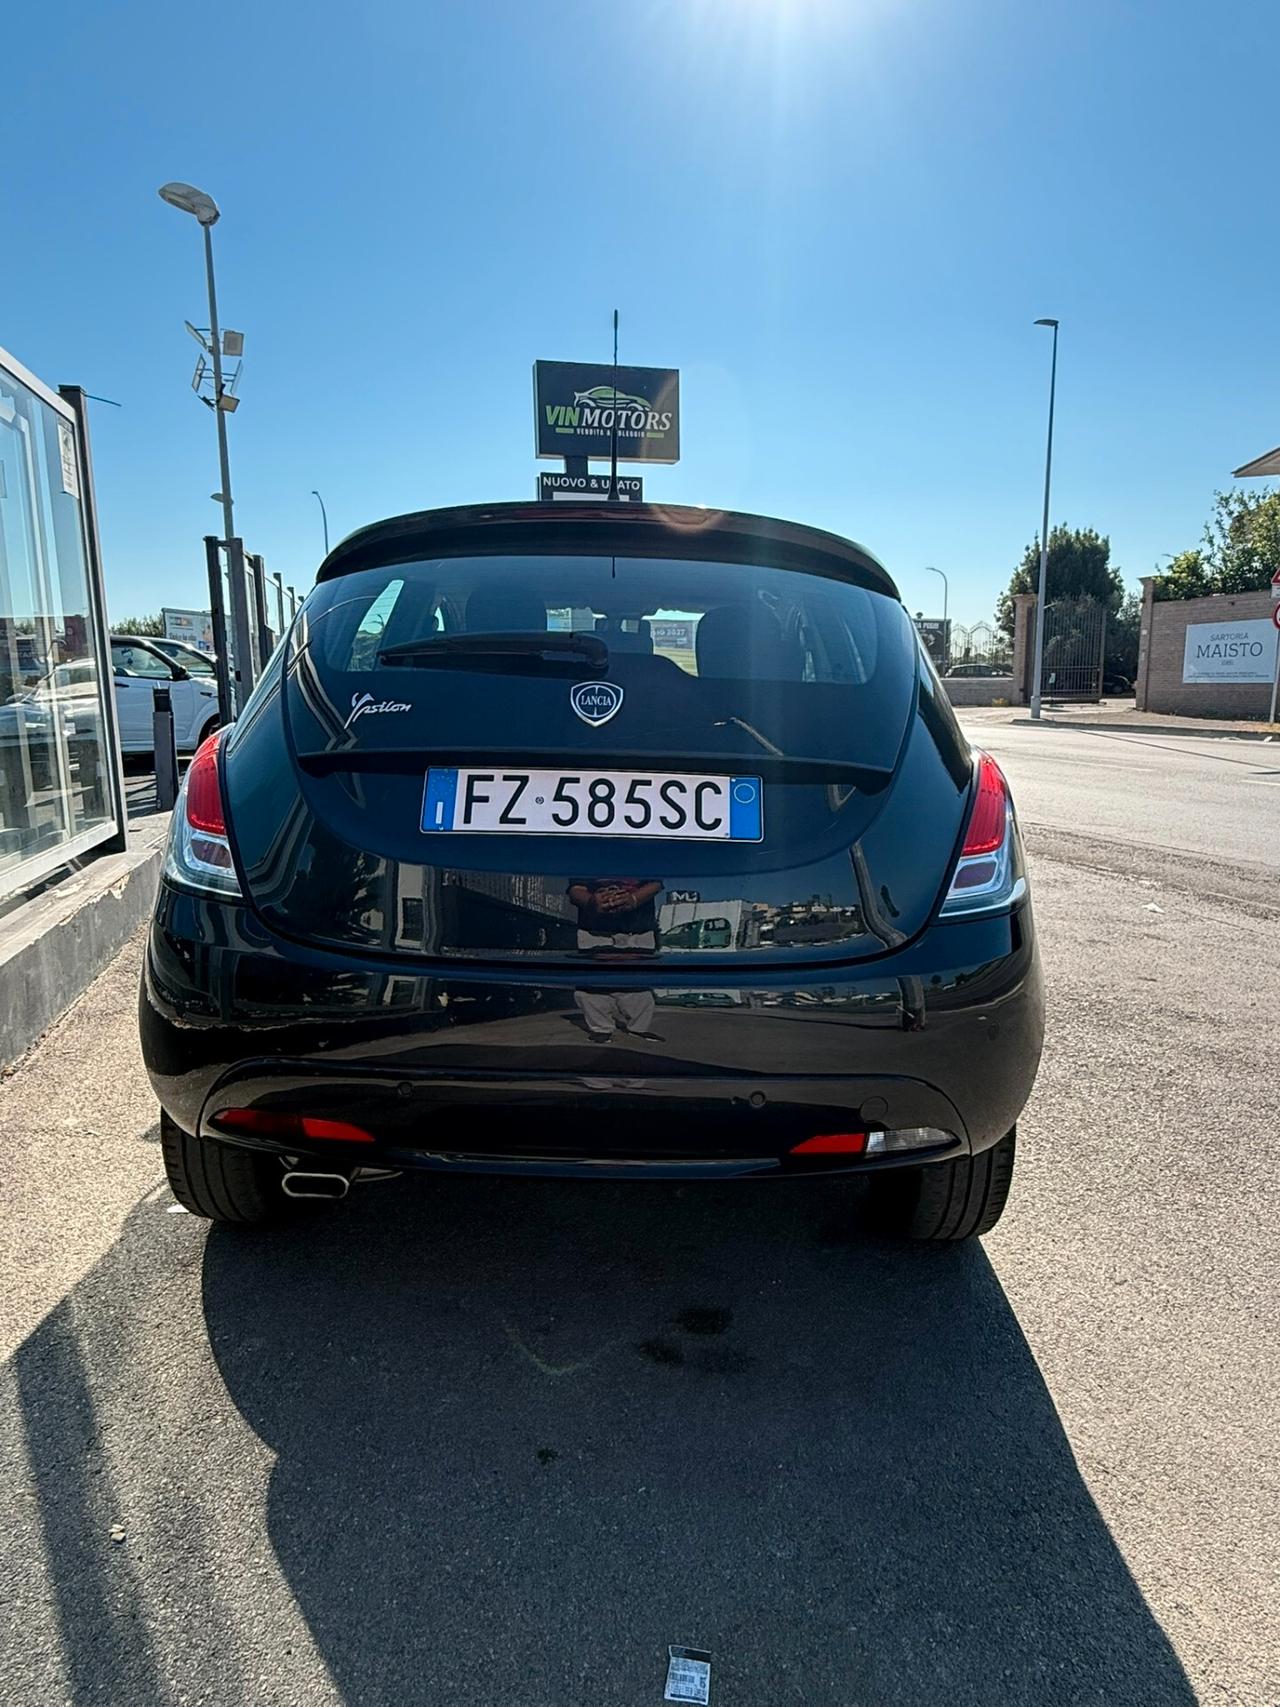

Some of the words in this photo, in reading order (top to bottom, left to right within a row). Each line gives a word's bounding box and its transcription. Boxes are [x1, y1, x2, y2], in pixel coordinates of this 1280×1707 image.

[546, 405, 580, 426] VIN
[582, 408, 672, 431] MOTORS
[576, 428, 604, 436] VENDITA
[543, 477, 586, 488] NUOVO
[590, 479, 598, 489] &
[601, 480, 640, 490] UATO
[1209, 632, 1249, 642] SARTORIA
[1196, 641, 1263, 659] MAISTO
[580, 695, 613, 706] LANCIA
[344, 692, 412, 729] Ypsilon
[463, 774, 530, 825] FZ
[551, 777, 723, 831] 585SC
